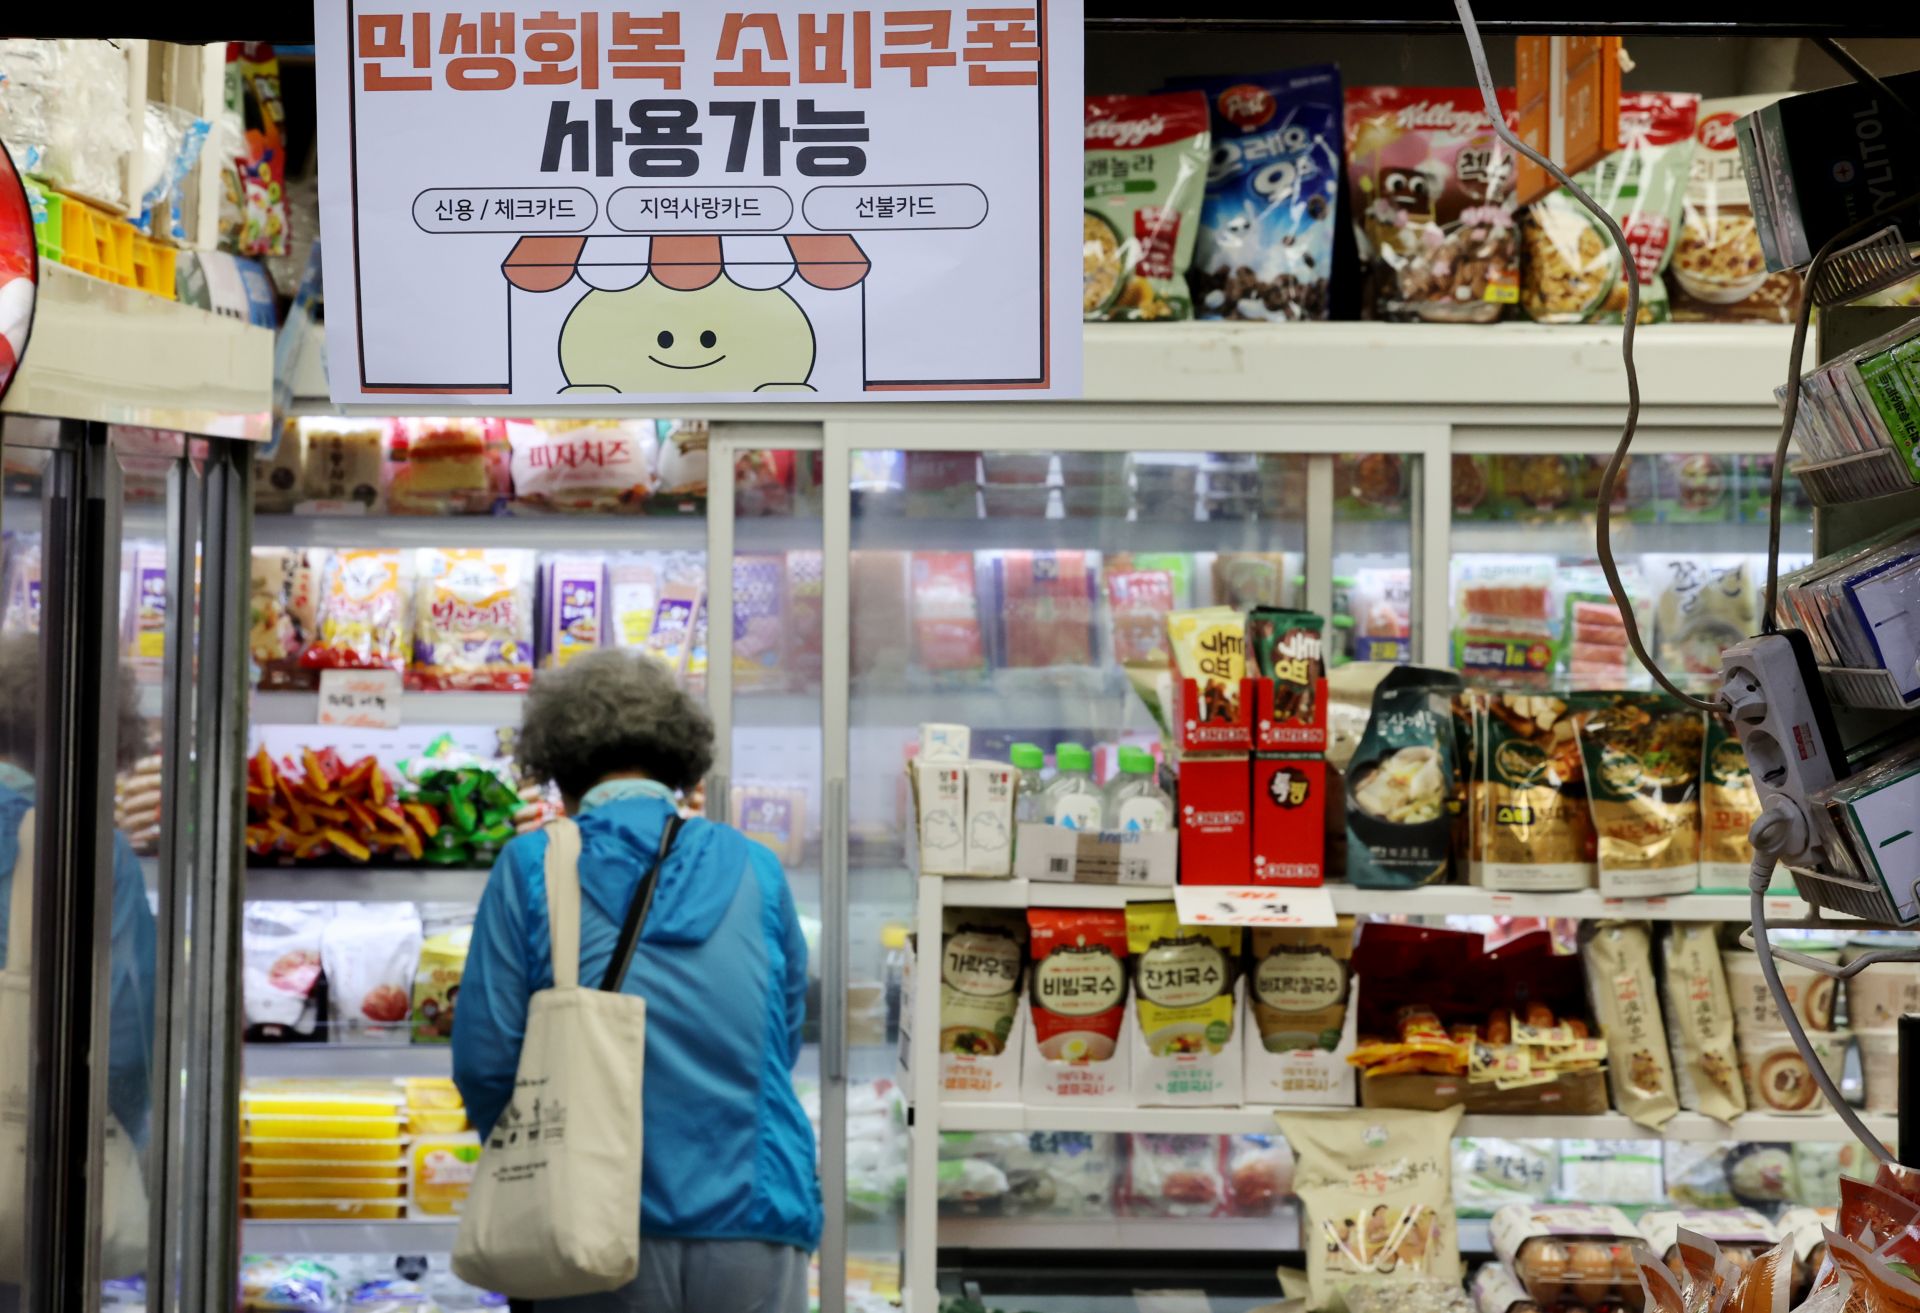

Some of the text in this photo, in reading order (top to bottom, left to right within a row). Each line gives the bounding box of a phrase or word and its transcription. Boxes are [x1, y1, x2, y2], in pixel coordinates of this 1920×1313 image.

[357, 8, 1041, 92] 민생회복 소비쿠폰
[540, 98, 870, 177] 사용가능
[1086, 153, 1154, 178] 래놀라
[1852, 100, 1897, 216] YLITOL
[434, 197, 577, 222] 신용 / 체크카드
[639, 196, 763, 220] 지역사랑카드
[854, 196, 937, 219] 선불카드
[529, 439, 631, 468] 피자치즈
[1196, 727, 1249, 742] ORION
[1270, 728, 1324, 742] ORION
[1196, 811, 1245, 825] ORION
[1266, 863, 1319, 878] ORION
[1042, 975, 1116, 996] 비빔국수
[1145, 965, 1220, 990] 잔치국수
